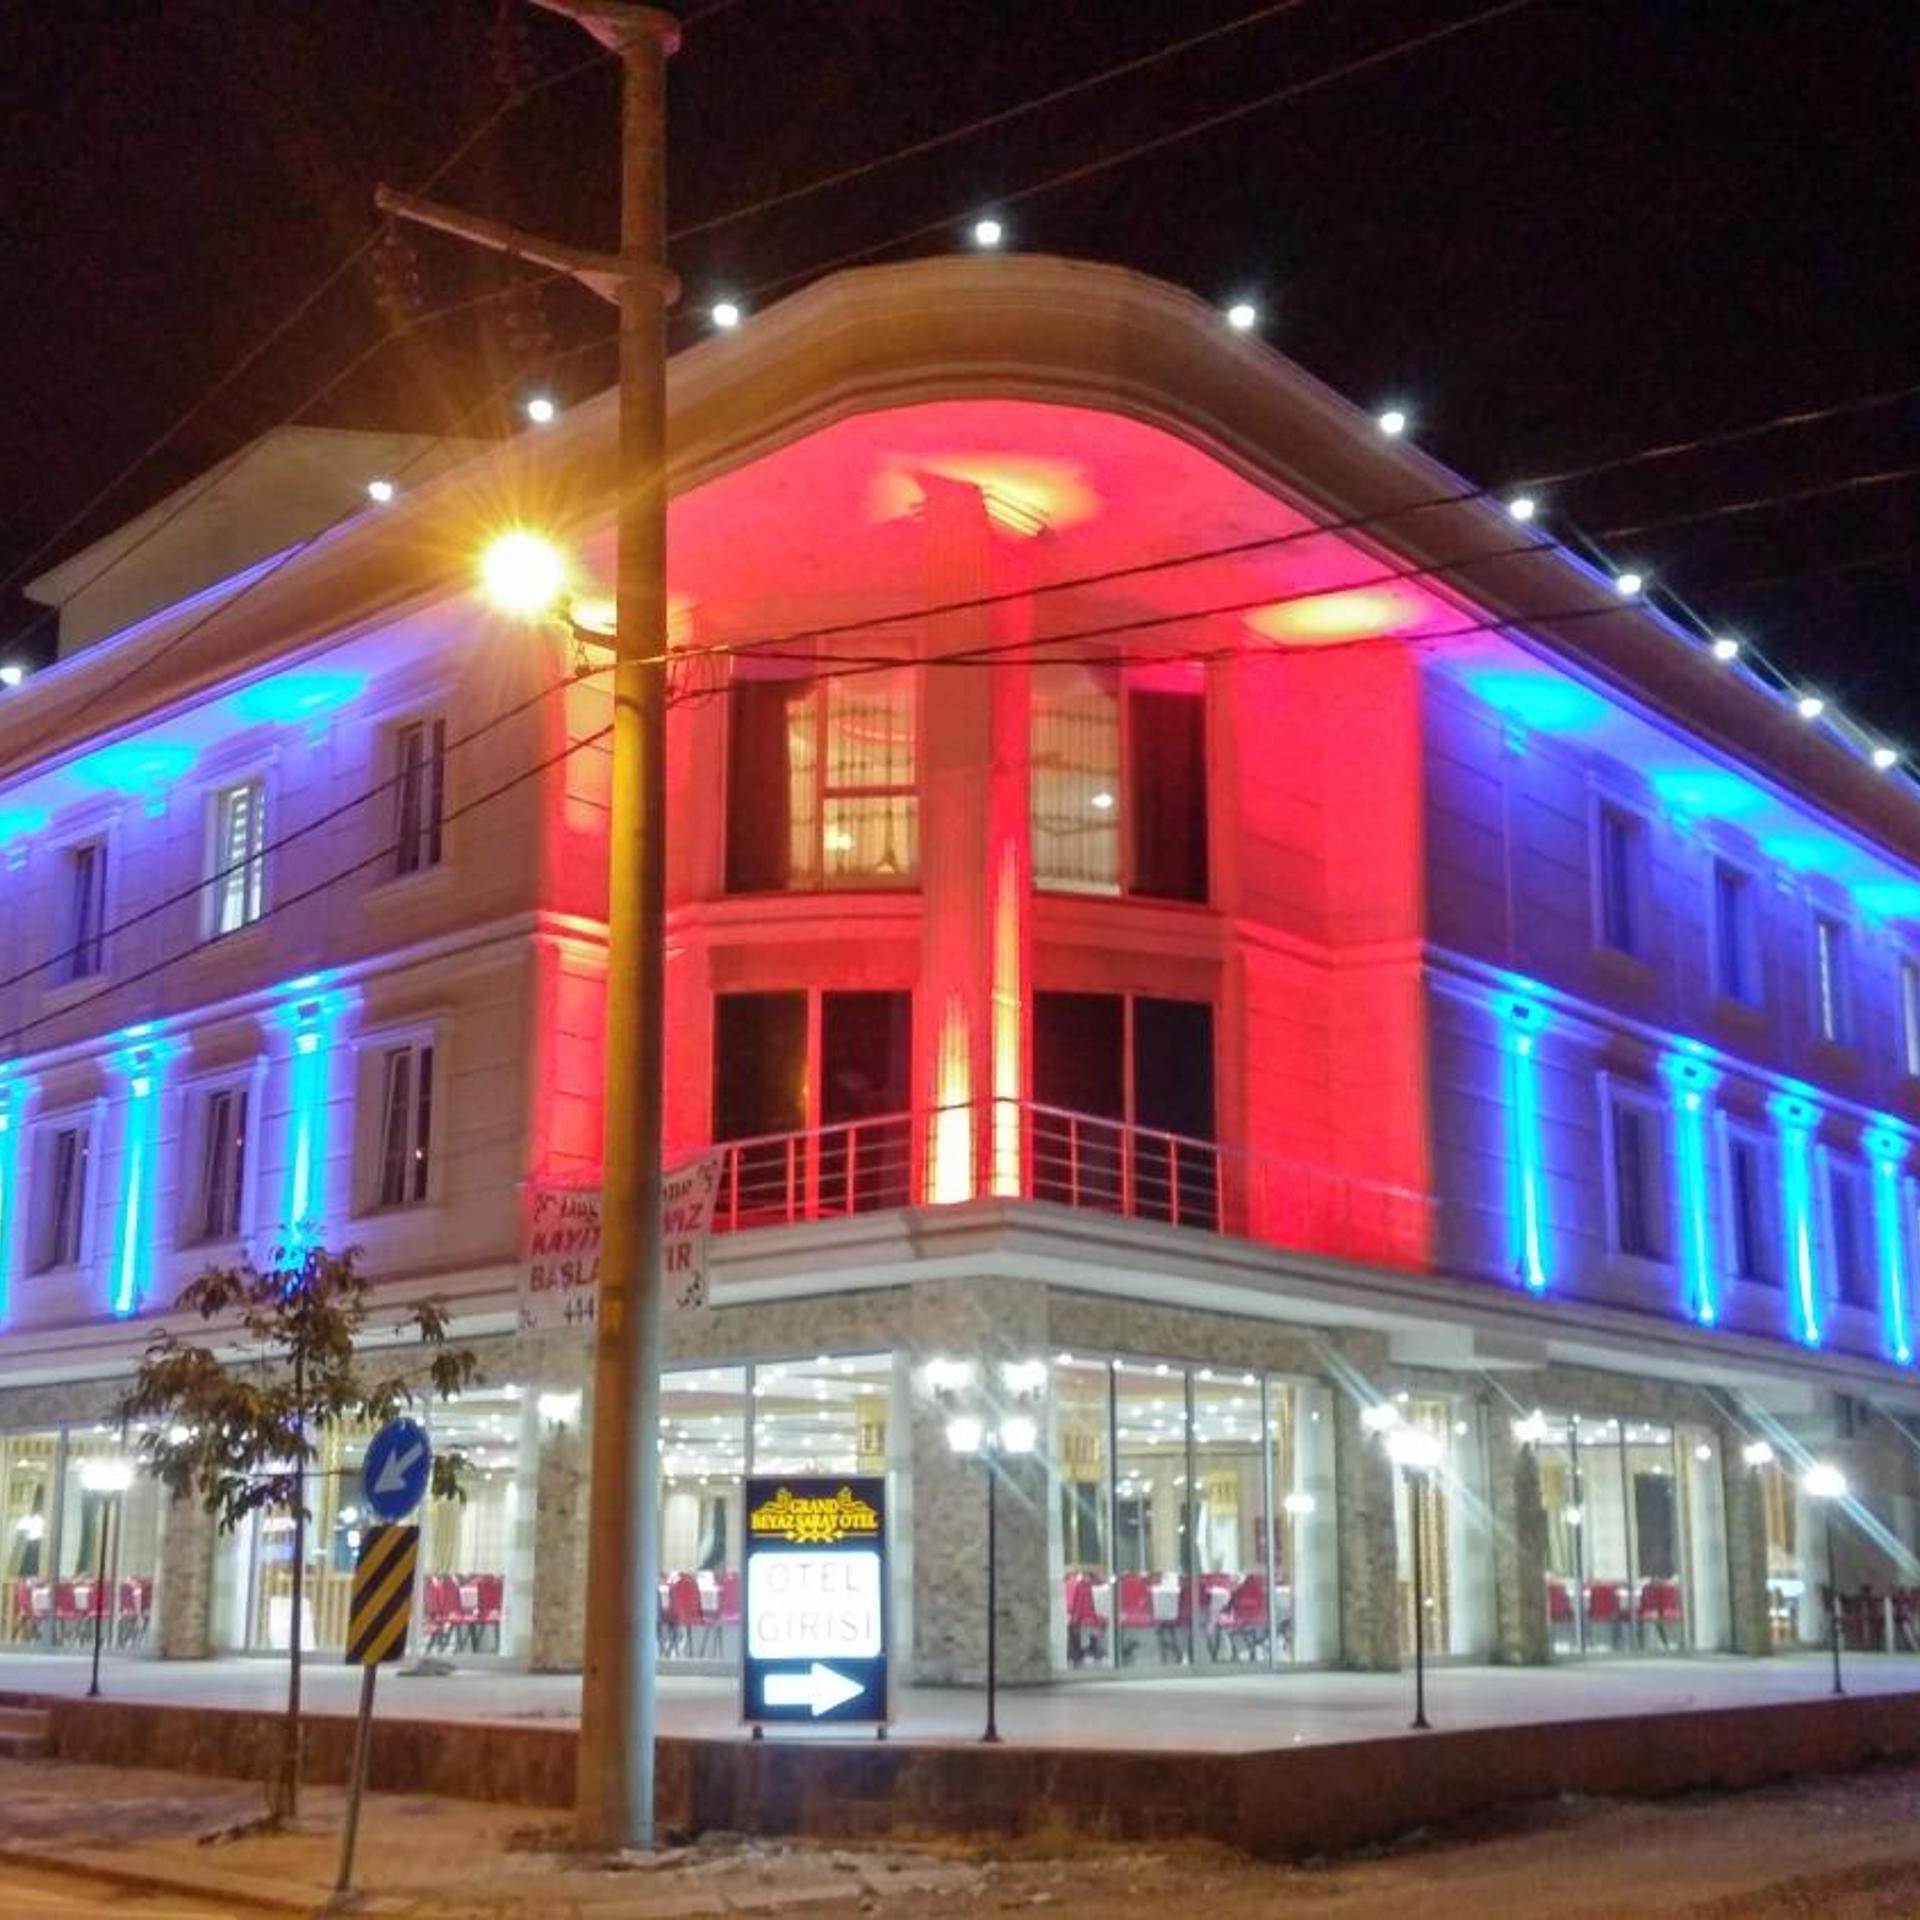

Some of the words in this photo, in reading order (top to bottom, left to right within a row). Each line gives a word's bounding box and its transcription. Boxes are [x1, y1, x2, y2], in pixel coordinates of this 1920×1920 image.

[791, 1498, 839, 1513] GRAND
[840, 1513, 878, 1529] OTEL
[767, 1562, 861, 1593] OTEL
